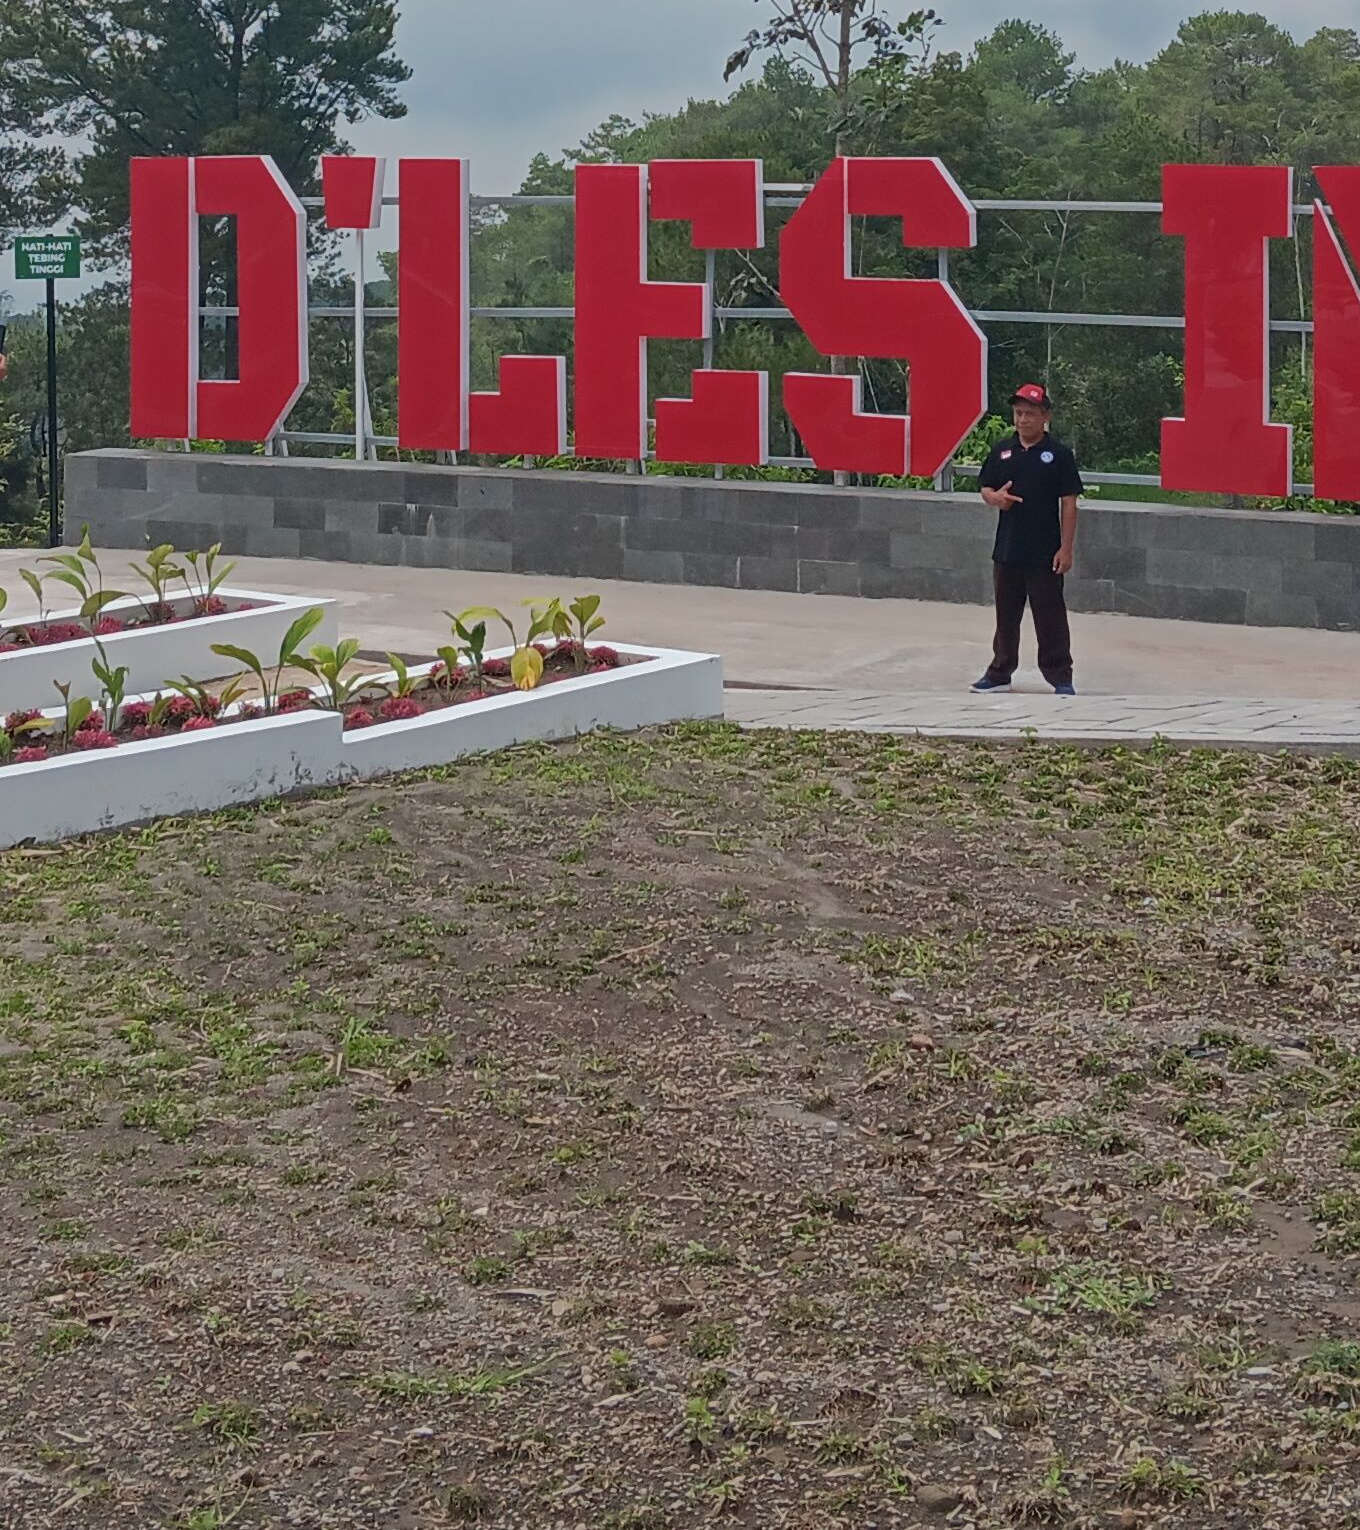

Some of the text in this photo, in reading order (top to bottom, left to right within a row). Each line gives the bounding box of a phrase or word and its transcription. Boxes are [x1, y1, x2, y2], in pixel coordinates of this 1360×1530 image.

[21, 241, 72, 252] HATI-HATI
[28, 253, 66, 263] TEBING
[30, 264, 64, 274] TINGGI
[130, 156, 989, 477] D'LES
